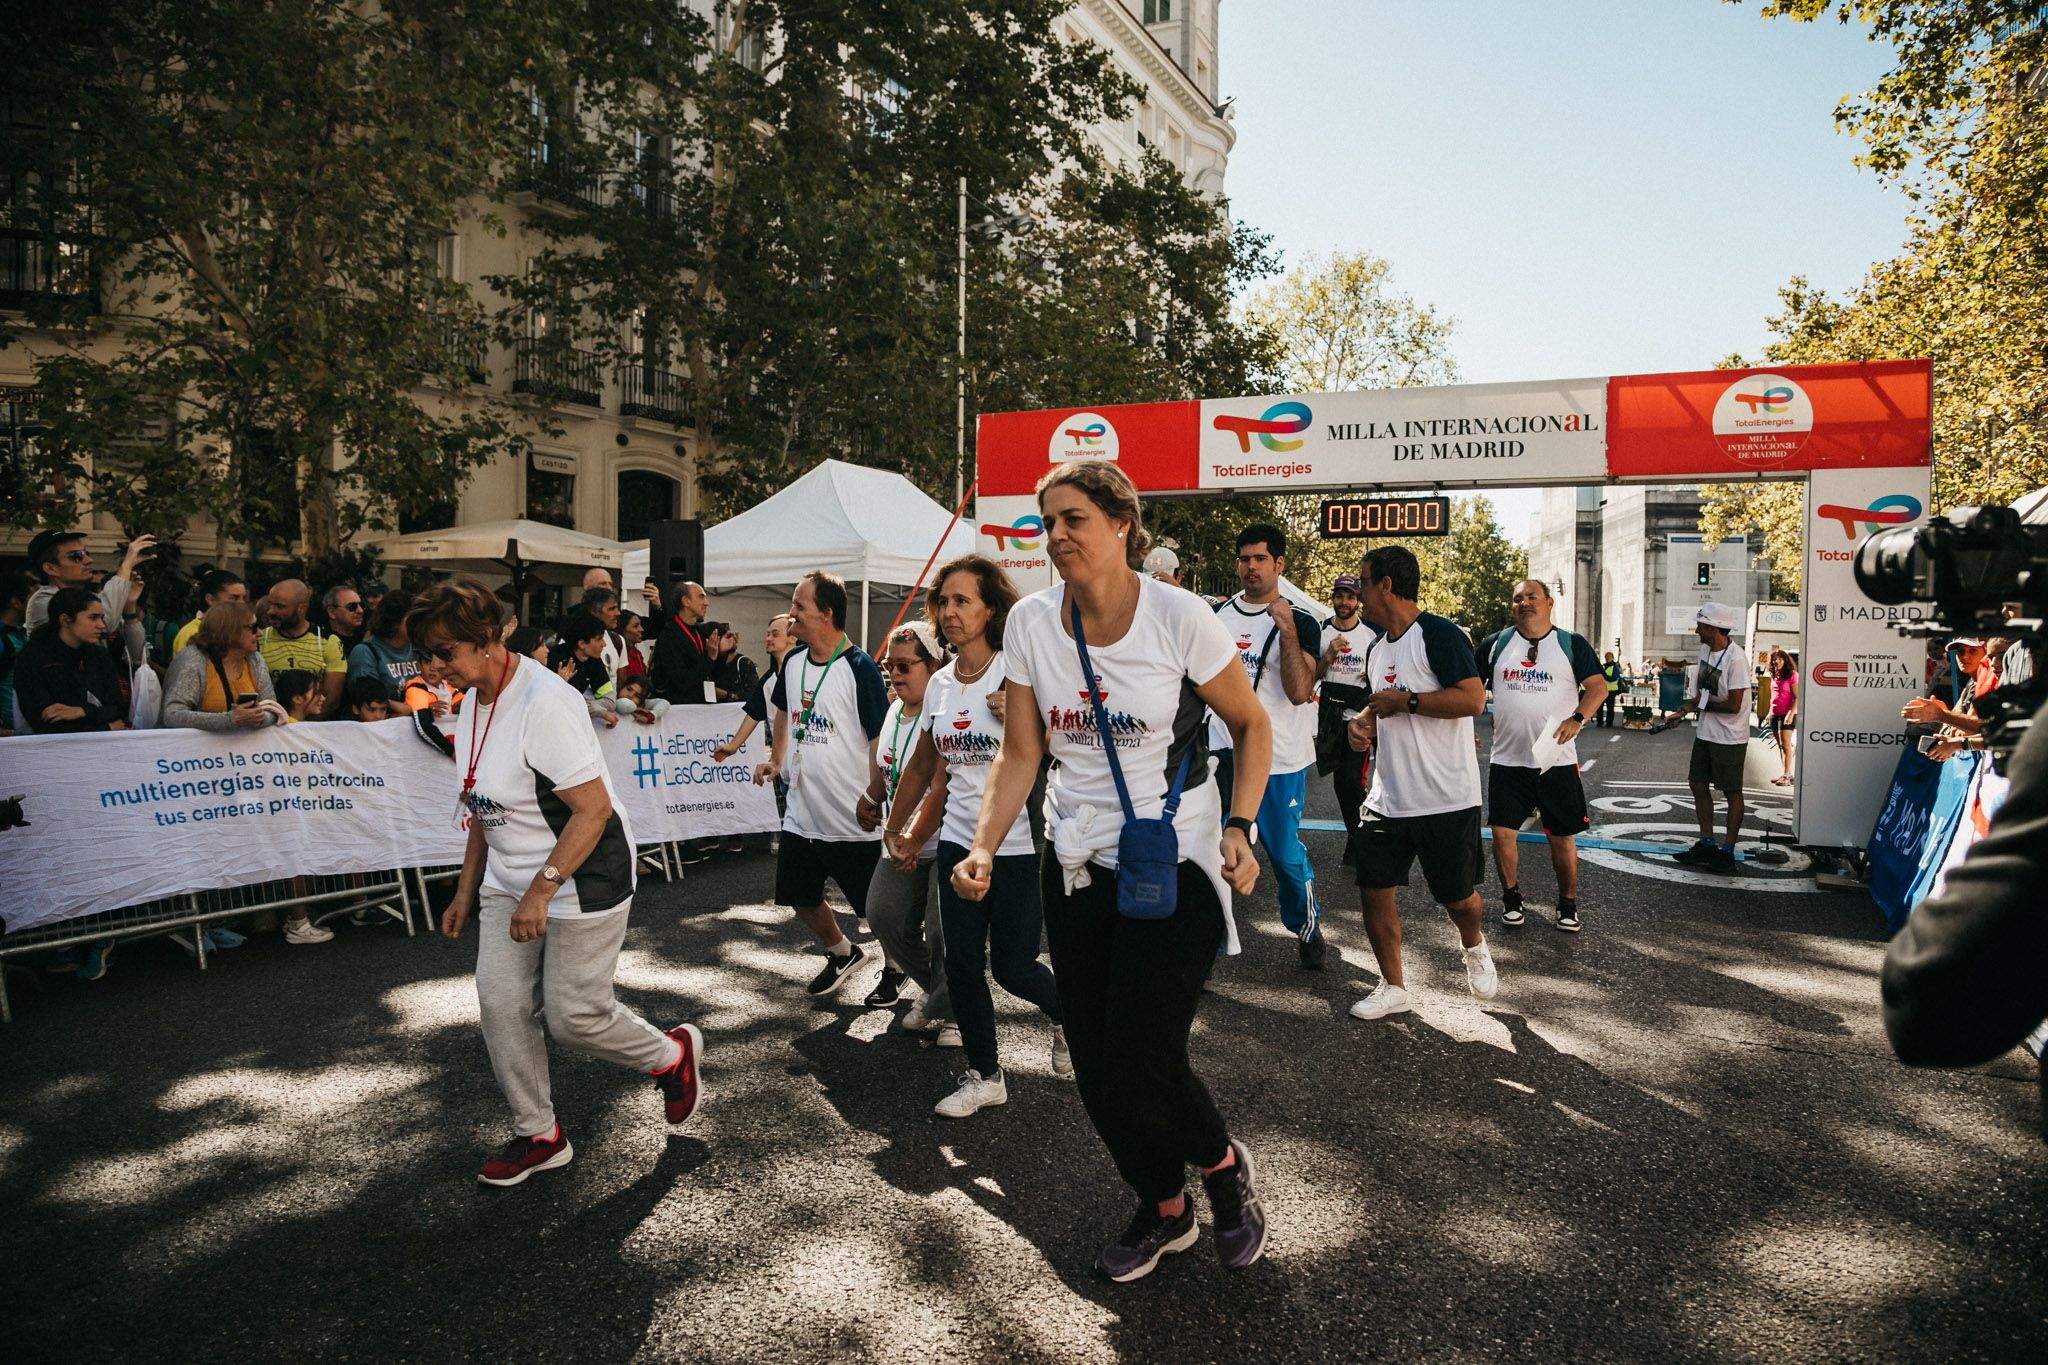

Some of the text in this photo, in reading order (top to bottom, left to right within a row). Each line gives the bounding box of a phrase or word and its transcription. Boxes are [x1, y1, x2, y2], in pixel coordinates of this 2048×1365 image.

[1734, 417, 1794, 428] TotalEnergies
[1326, 422, 1398, 441] MILLA
[1748, 435, 1777, 443] MILLA
[1063, 448, 1106, 457] TotalEnergies
[1392, 440, 1525, 461] DE MADRID
[1752, 450, 1788, 459] MADRID
[1212, 462, 1313, 479] TotalEnergies
[995, 557, 1047, 570] alEnergies
[1840, 606, 1922, 620] MADRID
[1852, 661, 1909, 675] MILLA
[1852, 675, 1918, 690] URBANA
[1063, 732, 1141, 748] Milla Uana
[1808, 730, 1908, 746] CORREDOR
[156, 750, 334, 775] Somos la compañía
[963, 752, 996, 763] Urbana
[662, 760, 751, 786] LasCarreras
[99, 772, 265, 808] multienergías
[307, 773, 385, 790] patrocina
[155, 811, 187, 827] tus
[192, 801, 264, 822] carreras
[665, 800, 735, 815] totaenergies.es
